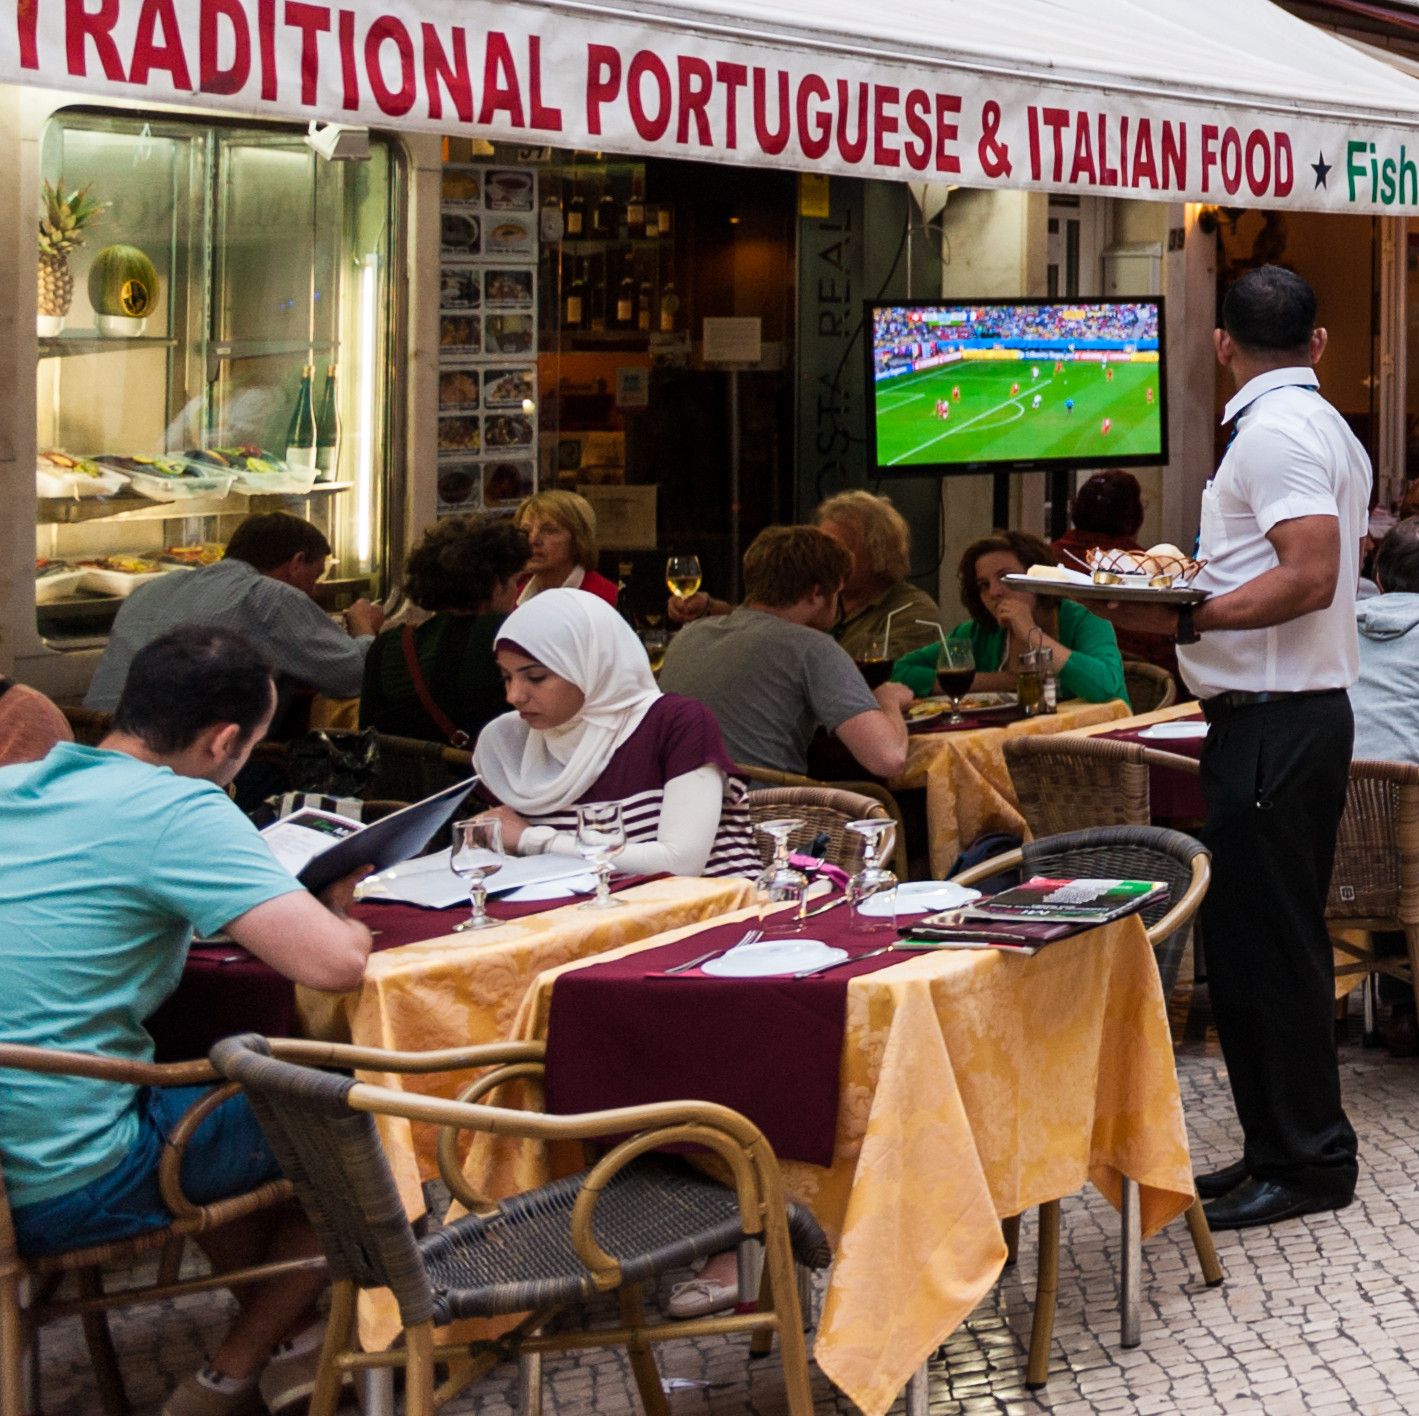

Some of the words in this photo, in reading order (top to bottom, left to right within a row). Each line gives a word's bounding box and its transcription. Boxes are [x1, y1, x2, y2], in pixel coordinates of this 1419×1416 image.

[586, 43, 962, 174] PORTUGUESE
[978, 99, 1012, 178] &
[1027, 105, 1187, 193] ITALIAN
[1201, 123, 1294, 198] FOOD
[1346, 141, 1419, 205] Fish
